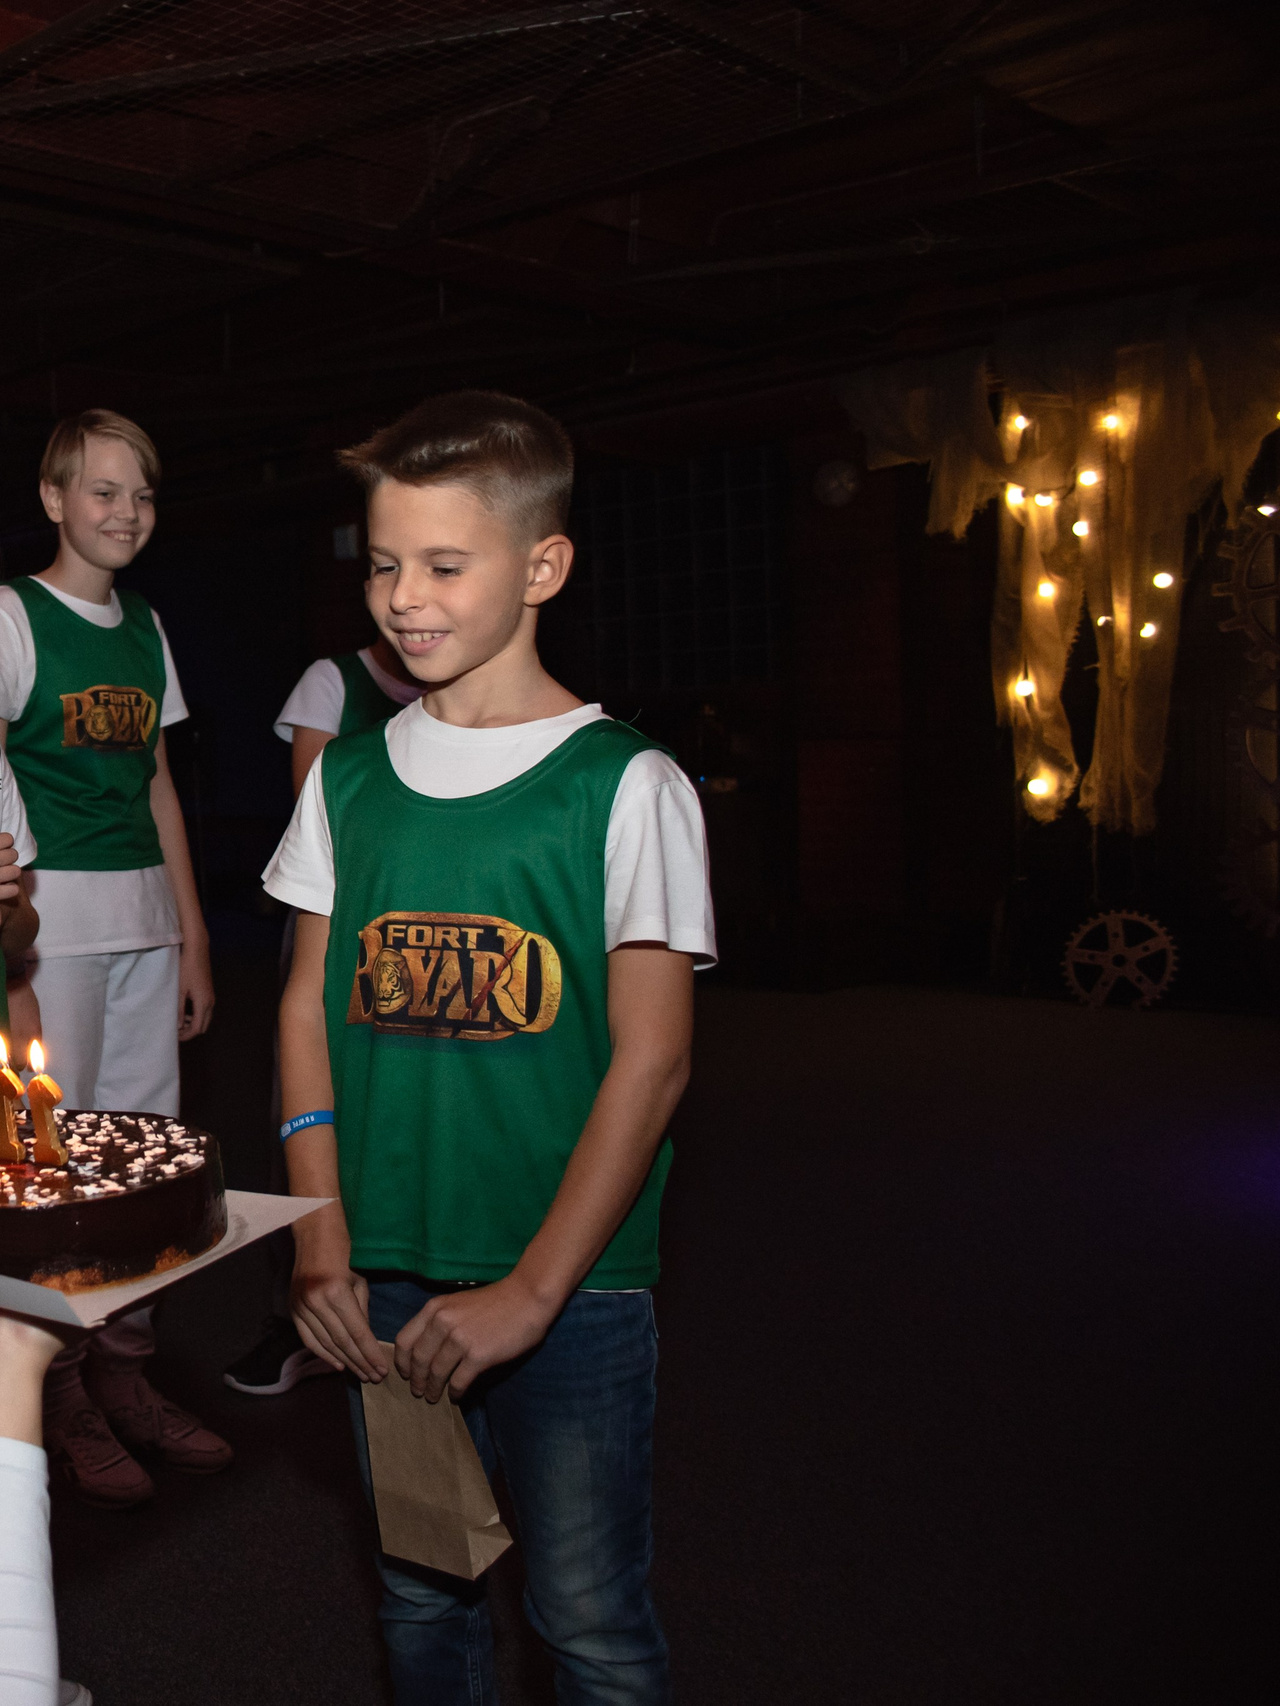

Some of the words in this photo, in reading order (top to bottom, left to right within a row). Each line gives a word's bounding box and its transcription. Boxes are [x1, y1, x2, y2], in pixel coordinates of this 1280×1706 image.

[99, 691, 138, 706] FORT
[386, 924, 484, 949] FORT
[346, 930, 562, 1033] BOYARD
